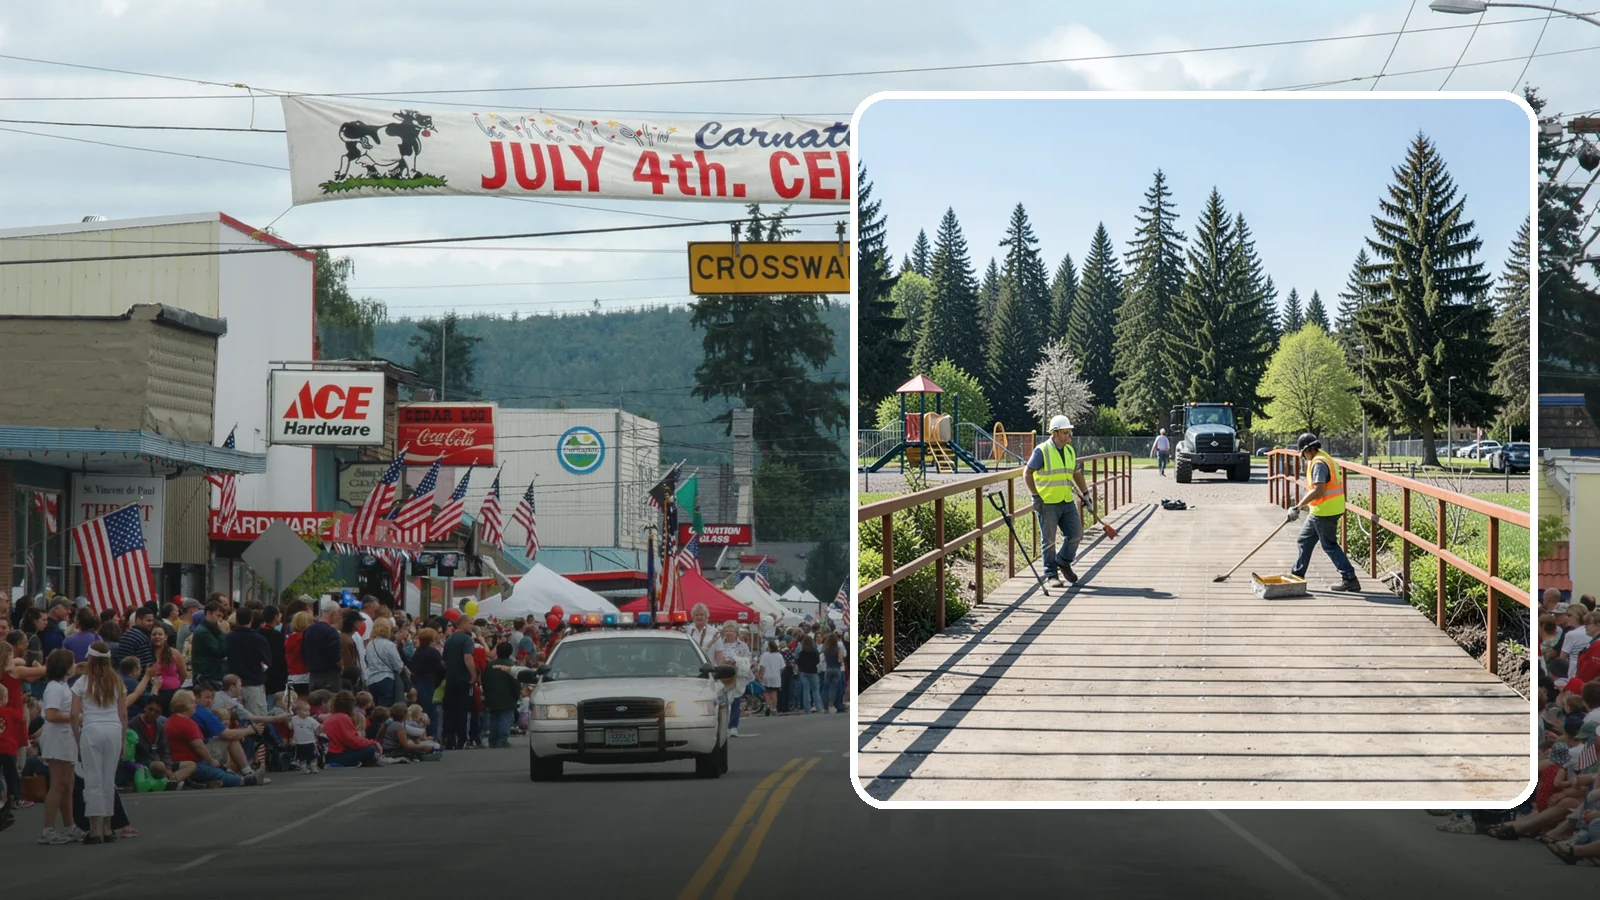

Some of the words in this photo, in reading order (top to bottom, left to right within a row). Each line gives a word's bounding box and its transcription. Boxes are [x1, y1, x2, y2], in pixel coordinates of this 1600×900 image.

[695, 121, 850, 149] Carnat
[481, 141, 605, 192] JULY
[632, 150, 746, 197] 4th.
[697, 254, 850, 280] CROSSWA
[282, 380, 373, 420] ACE
[406, 410, 453, 422] CEDAR
[283, 421, 371, 437] Hardware
[416, 428, 477, 447] Coca-Cola
[353, 467, 386, 480] Simpl
[83, 485, 94, 494] St.
[96, 485, 124, 495] Vincent
[126, 486, 136, 495] de
[138, 486, 155, 495] Paul
[80, 503, 153, 522] THT
[213, 516, 330, 535] HARDARE
[688, 526, 741, 535] CRNATION
[699, 535, 730, 544] GLASS
